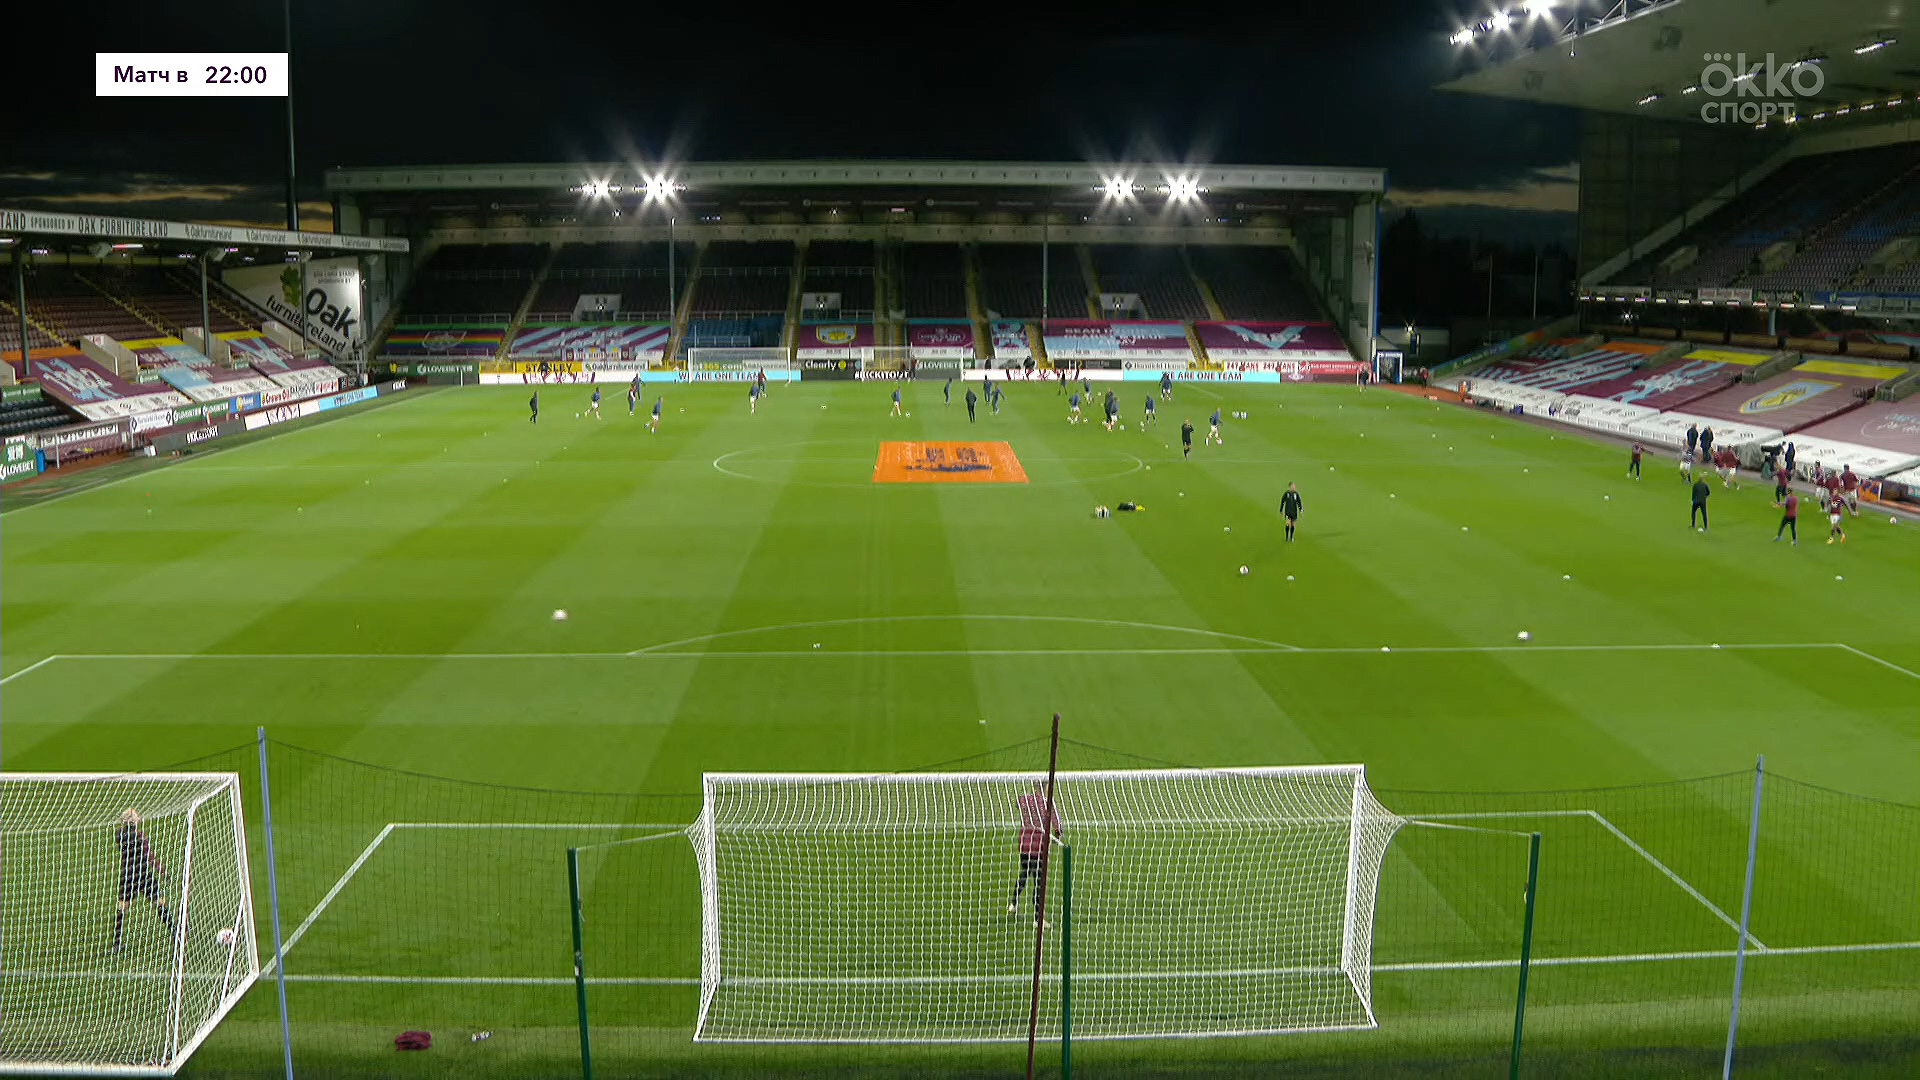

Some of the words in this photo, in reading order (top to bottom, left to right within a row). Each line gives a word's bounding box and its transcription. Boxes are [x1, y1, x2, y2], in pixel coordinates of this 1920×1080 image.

[30, 216, 65, 230] SPONSORED
[66, 219, 75, 230] BY
[78, 216, 96, 234] OAK
[306, 287, 357, 339] Oak
[805, 361, 837, 371] Clearly
[694, 372, 710, 380] ARE
[714, 372, 732, 380] ONE
[736, 372, 760, 380] TEAM
[1178, 372, 1195, 380] ARE
[1198, 372, 1216, 380] ONE
[1218, 372, 1243, 381] TEAM
